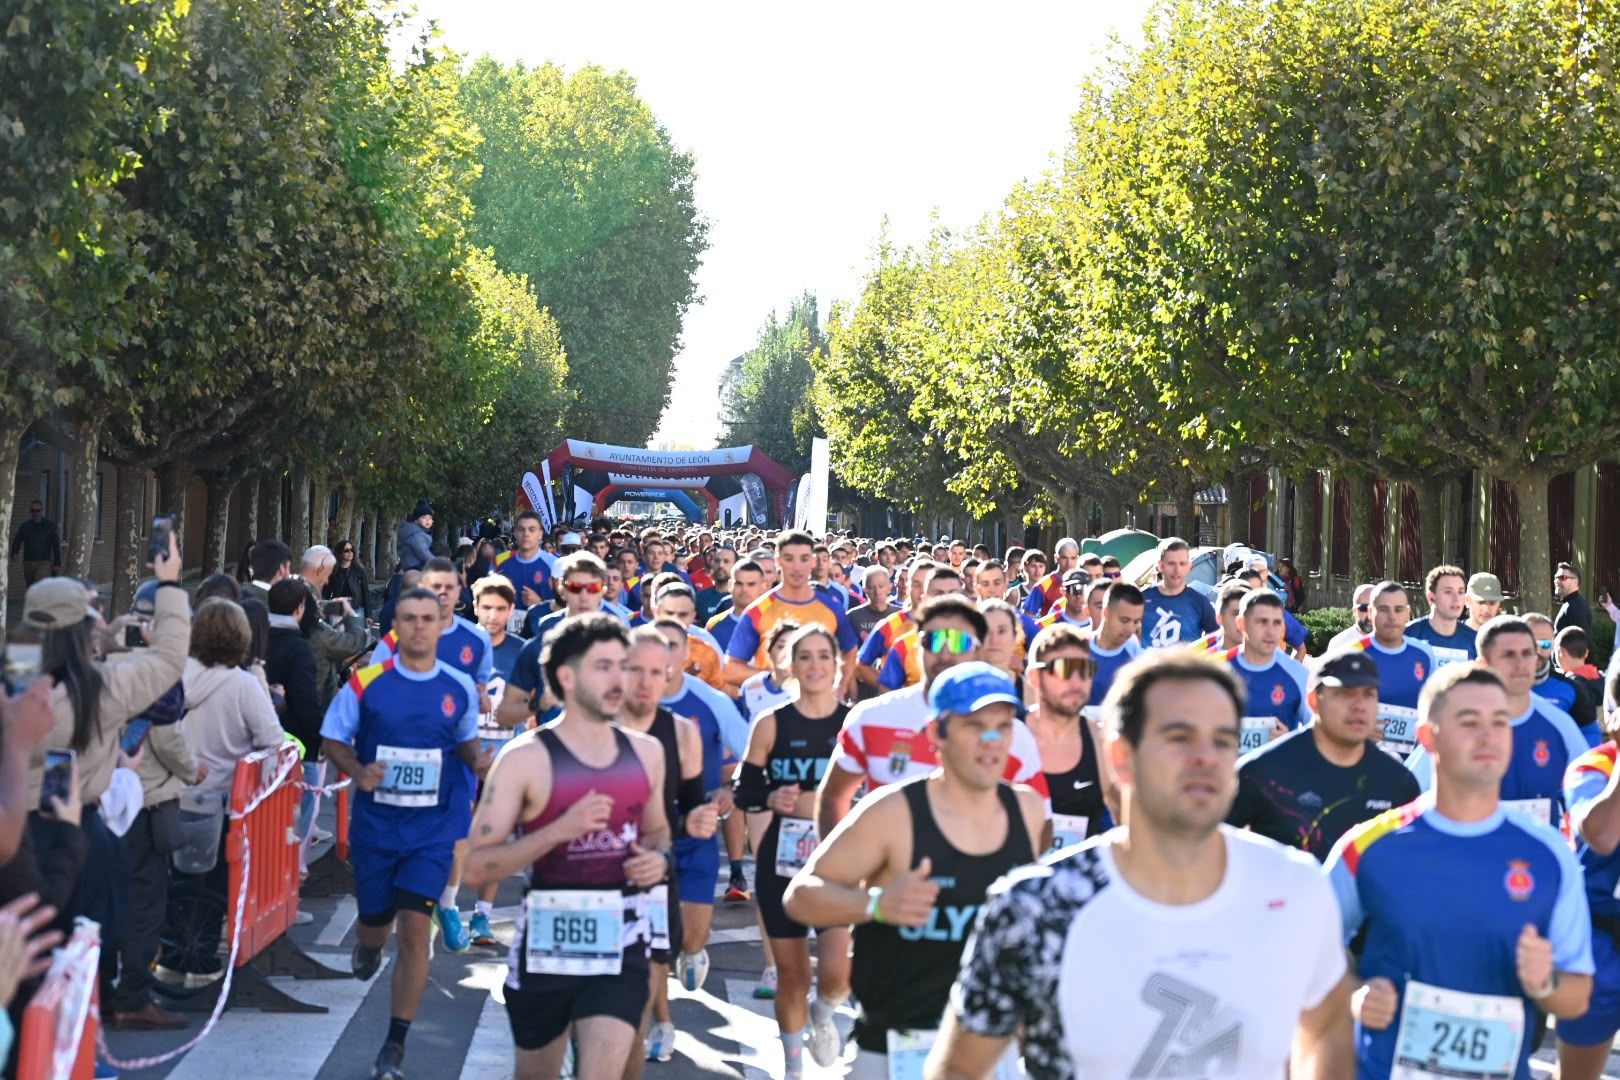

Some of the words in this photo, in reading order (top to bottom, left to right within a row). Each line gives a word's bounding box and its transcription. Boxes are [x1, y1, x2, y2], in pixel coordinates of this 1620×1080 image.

[609, 452, 673, 465] AYUNTAMIENTO
[675, 456, 687, 464] DE
[688, 455, 710, 464] LEÓN
[392, 765, 424, 785] 789
[553, 917, 597, 944] 669
[1431, 1021, 1489, 1061] 246
